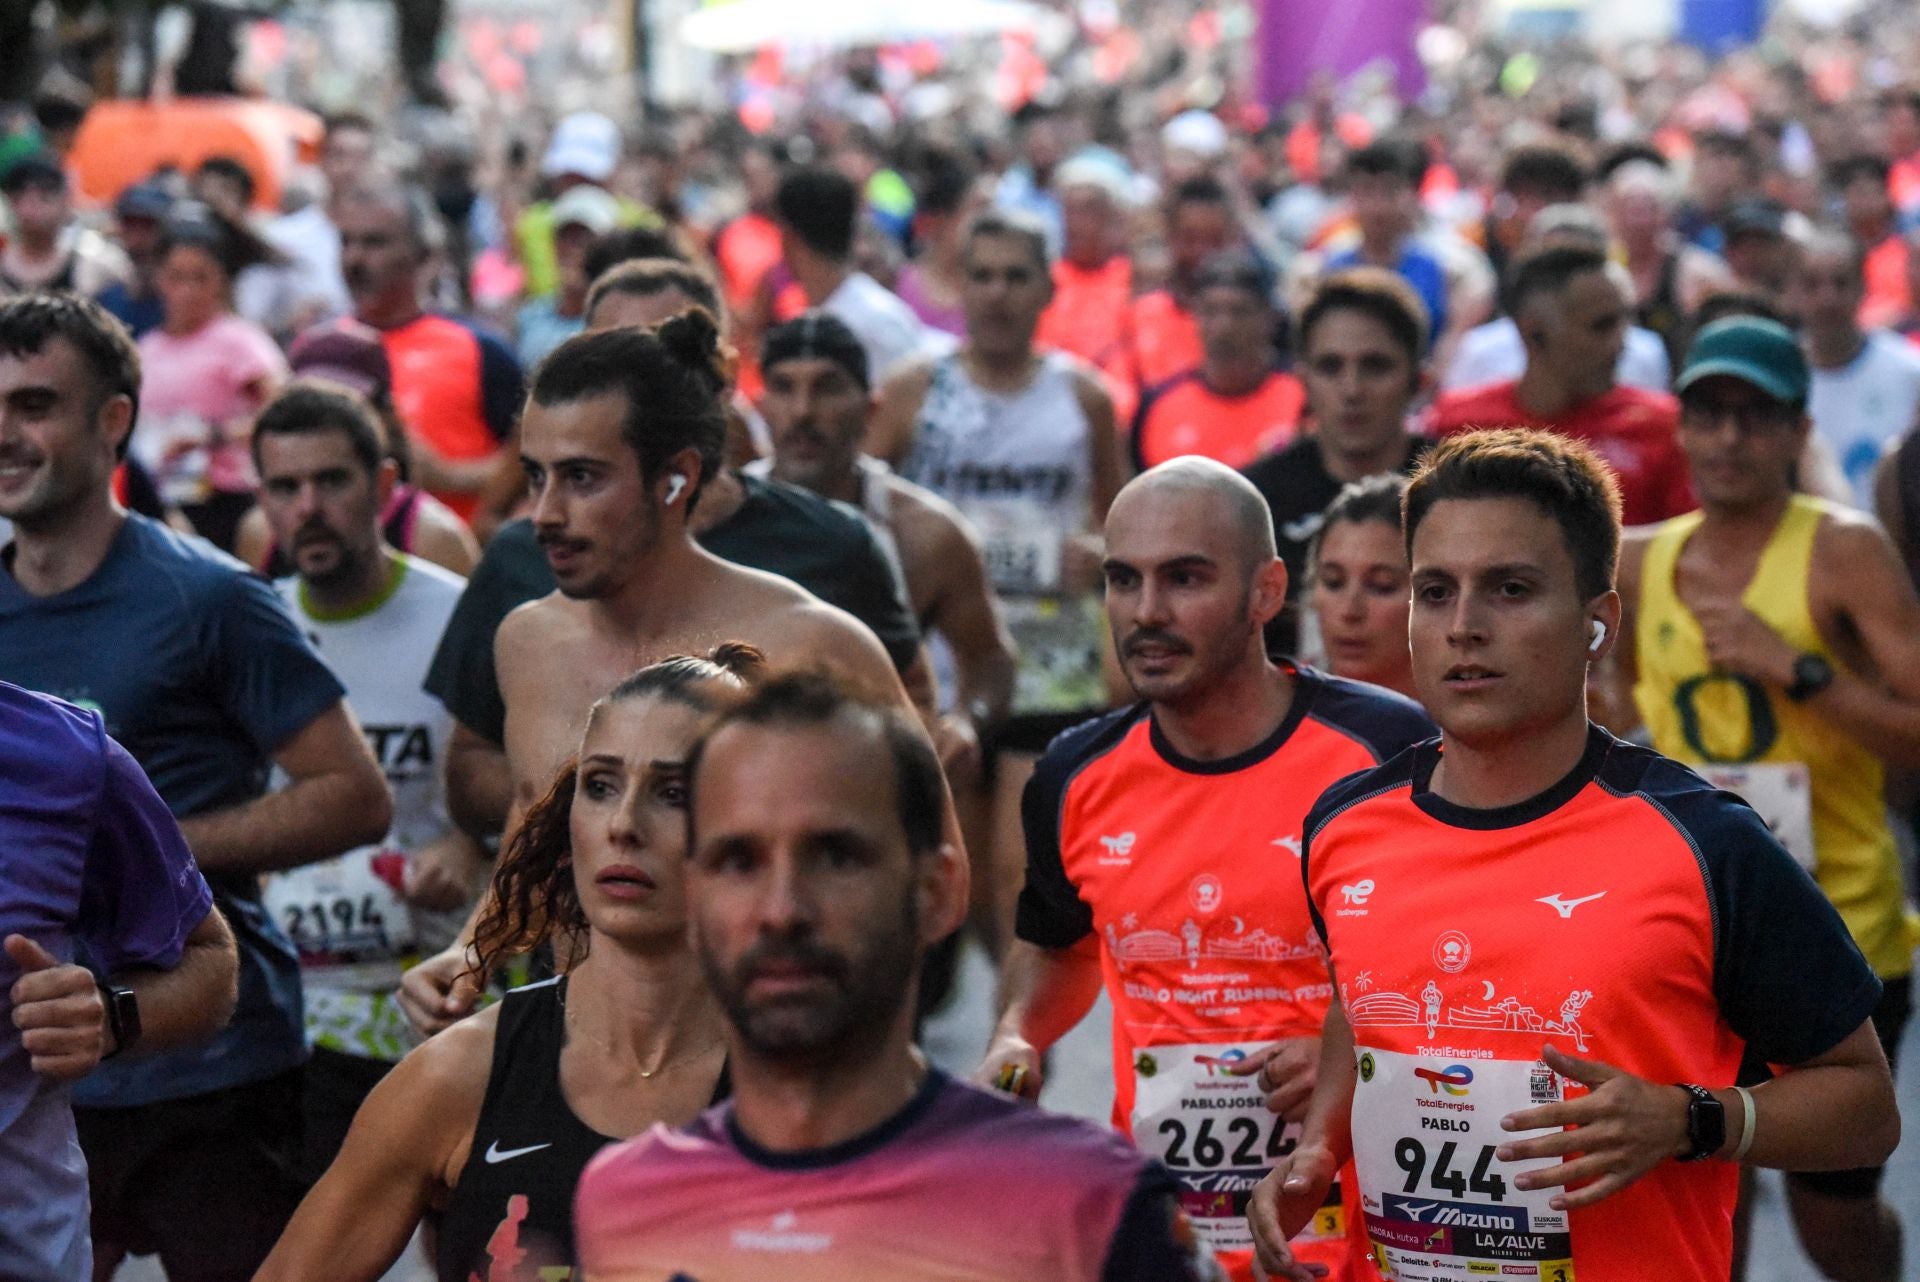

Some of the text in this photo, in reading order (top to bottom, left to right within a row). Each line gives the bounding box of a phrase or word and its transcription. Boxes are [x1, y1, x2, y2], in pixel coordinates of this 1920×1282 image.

[1416, 1046, 1494, 1059] TotalEnergies
[1181, 1097, 1266, 1109] PABLOJOSE
[1416, 1098, 1475, 1112] TotalEnergies
[1421, 1117, 1471, 1132] PABLO
[1158, 1116, 1298, 1167] 2624
[1394, 1137, 1507, 1202] 944
[1325, 1216, 1336, 1231] 3
[1475, 1232, 1496, 1247] LA
